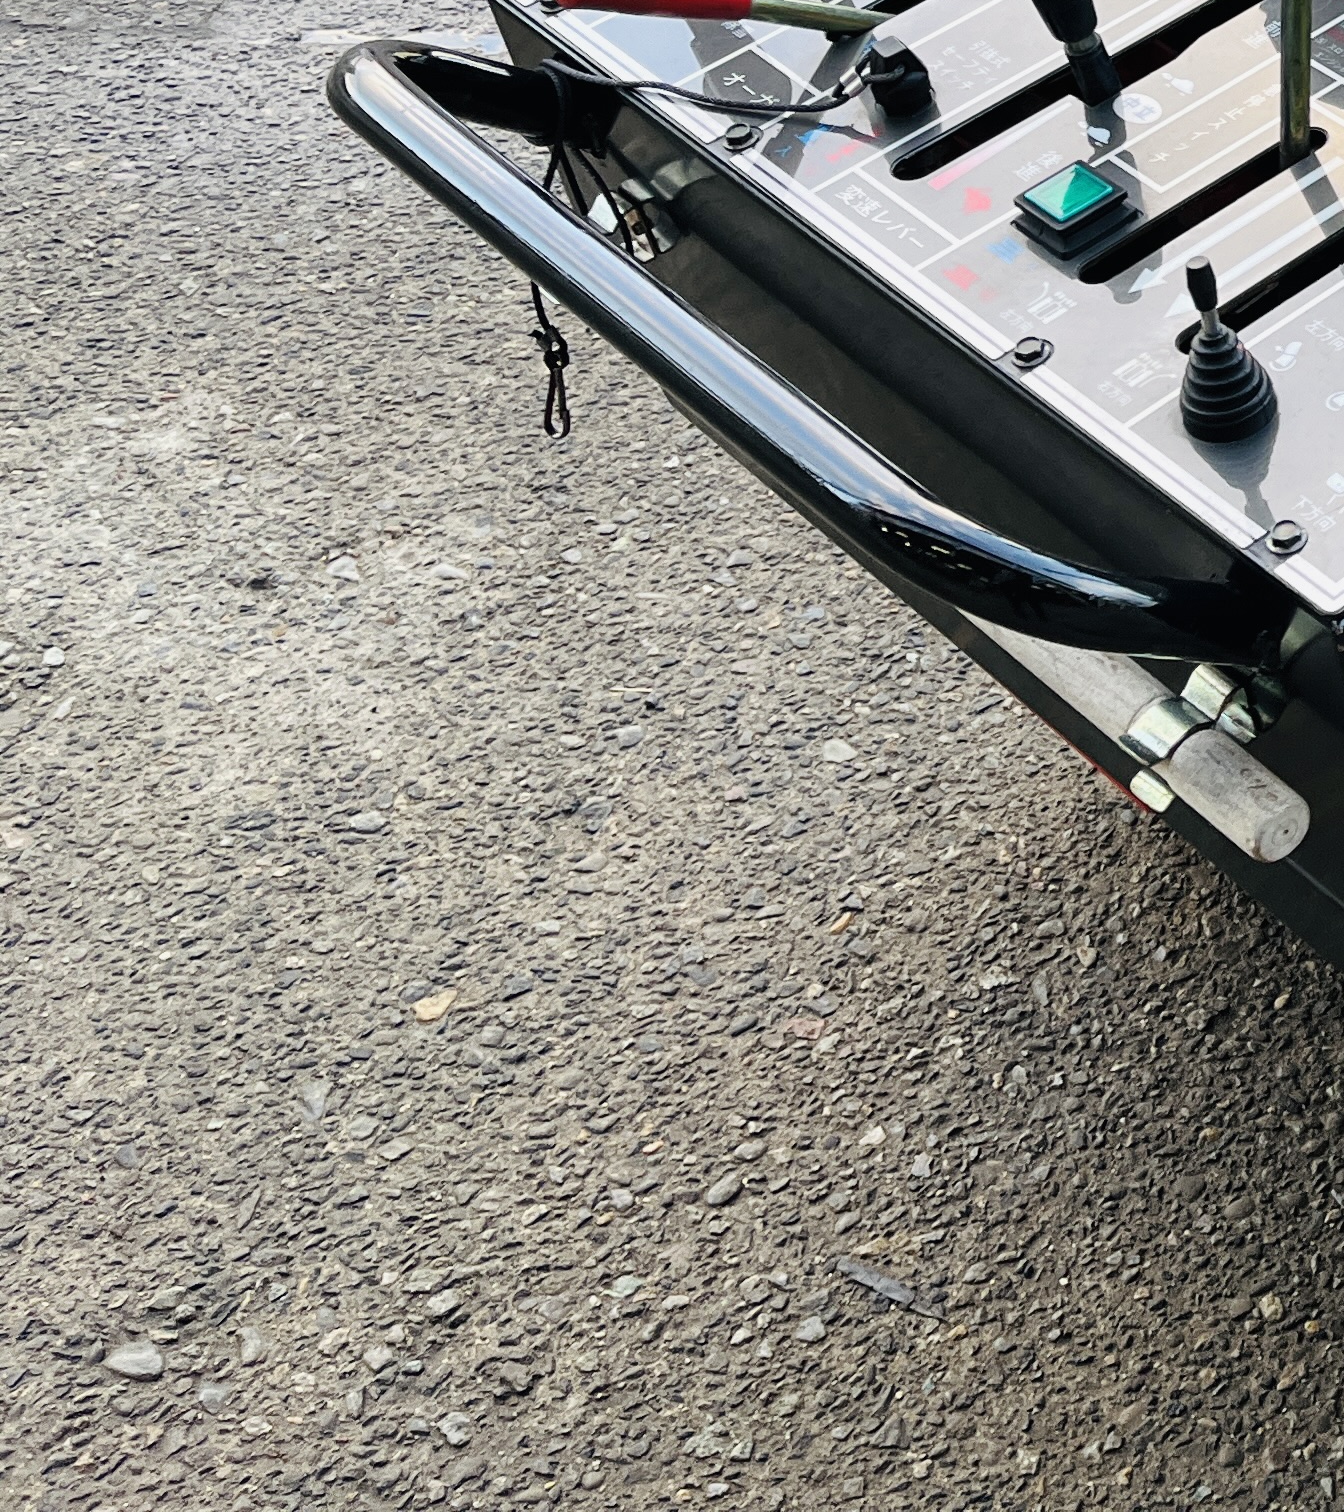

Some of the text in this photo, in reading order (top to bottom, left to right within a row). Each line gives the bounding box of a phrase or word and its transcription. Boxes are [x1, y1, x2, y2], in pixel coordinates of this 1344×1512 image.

[833, 184, 924, 249] 変速レバー
[1291, 494, 1338, 533] 下方向
